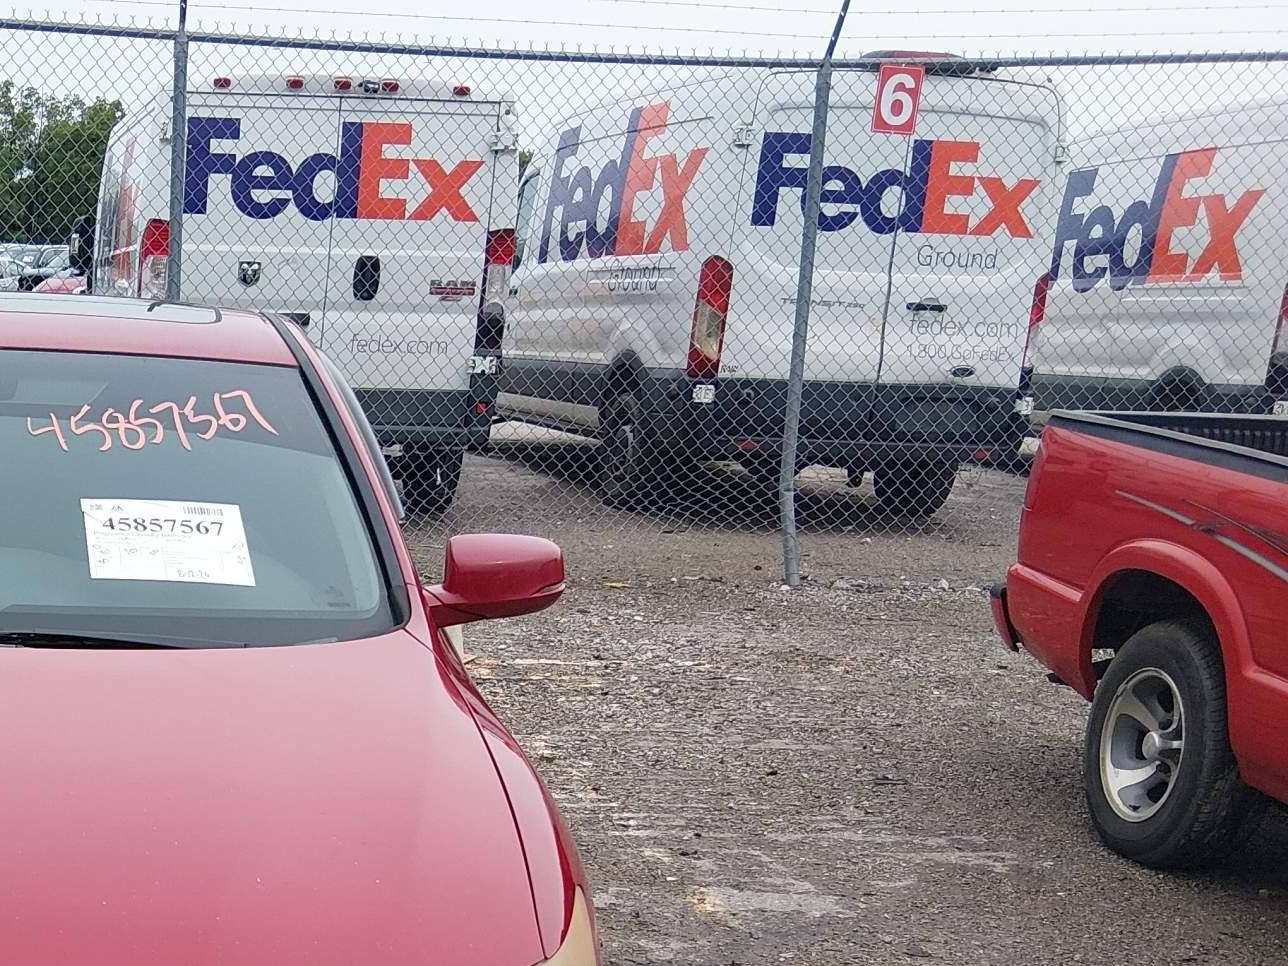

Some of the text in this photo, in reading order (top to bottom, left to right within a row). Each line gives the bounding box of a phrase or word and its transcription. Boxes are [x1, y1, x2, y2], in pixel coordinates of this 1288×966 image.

[881, 73, 916, 127] 6
[183, 117, 486, 222] FedEx
[538, 101, 711, 264] FedEx
[751, 132, 1042, 239] FedEx
[1047, 147, 1267, 293] FedEx
[917, 244, 999, 269] Ground
[351, 335, 448, 354] fedex.com
[909, 312, 1018, 337] fedex.com
[27, 390, 280, 452] 45857567
[102, 517, 224, 536] 45857567
